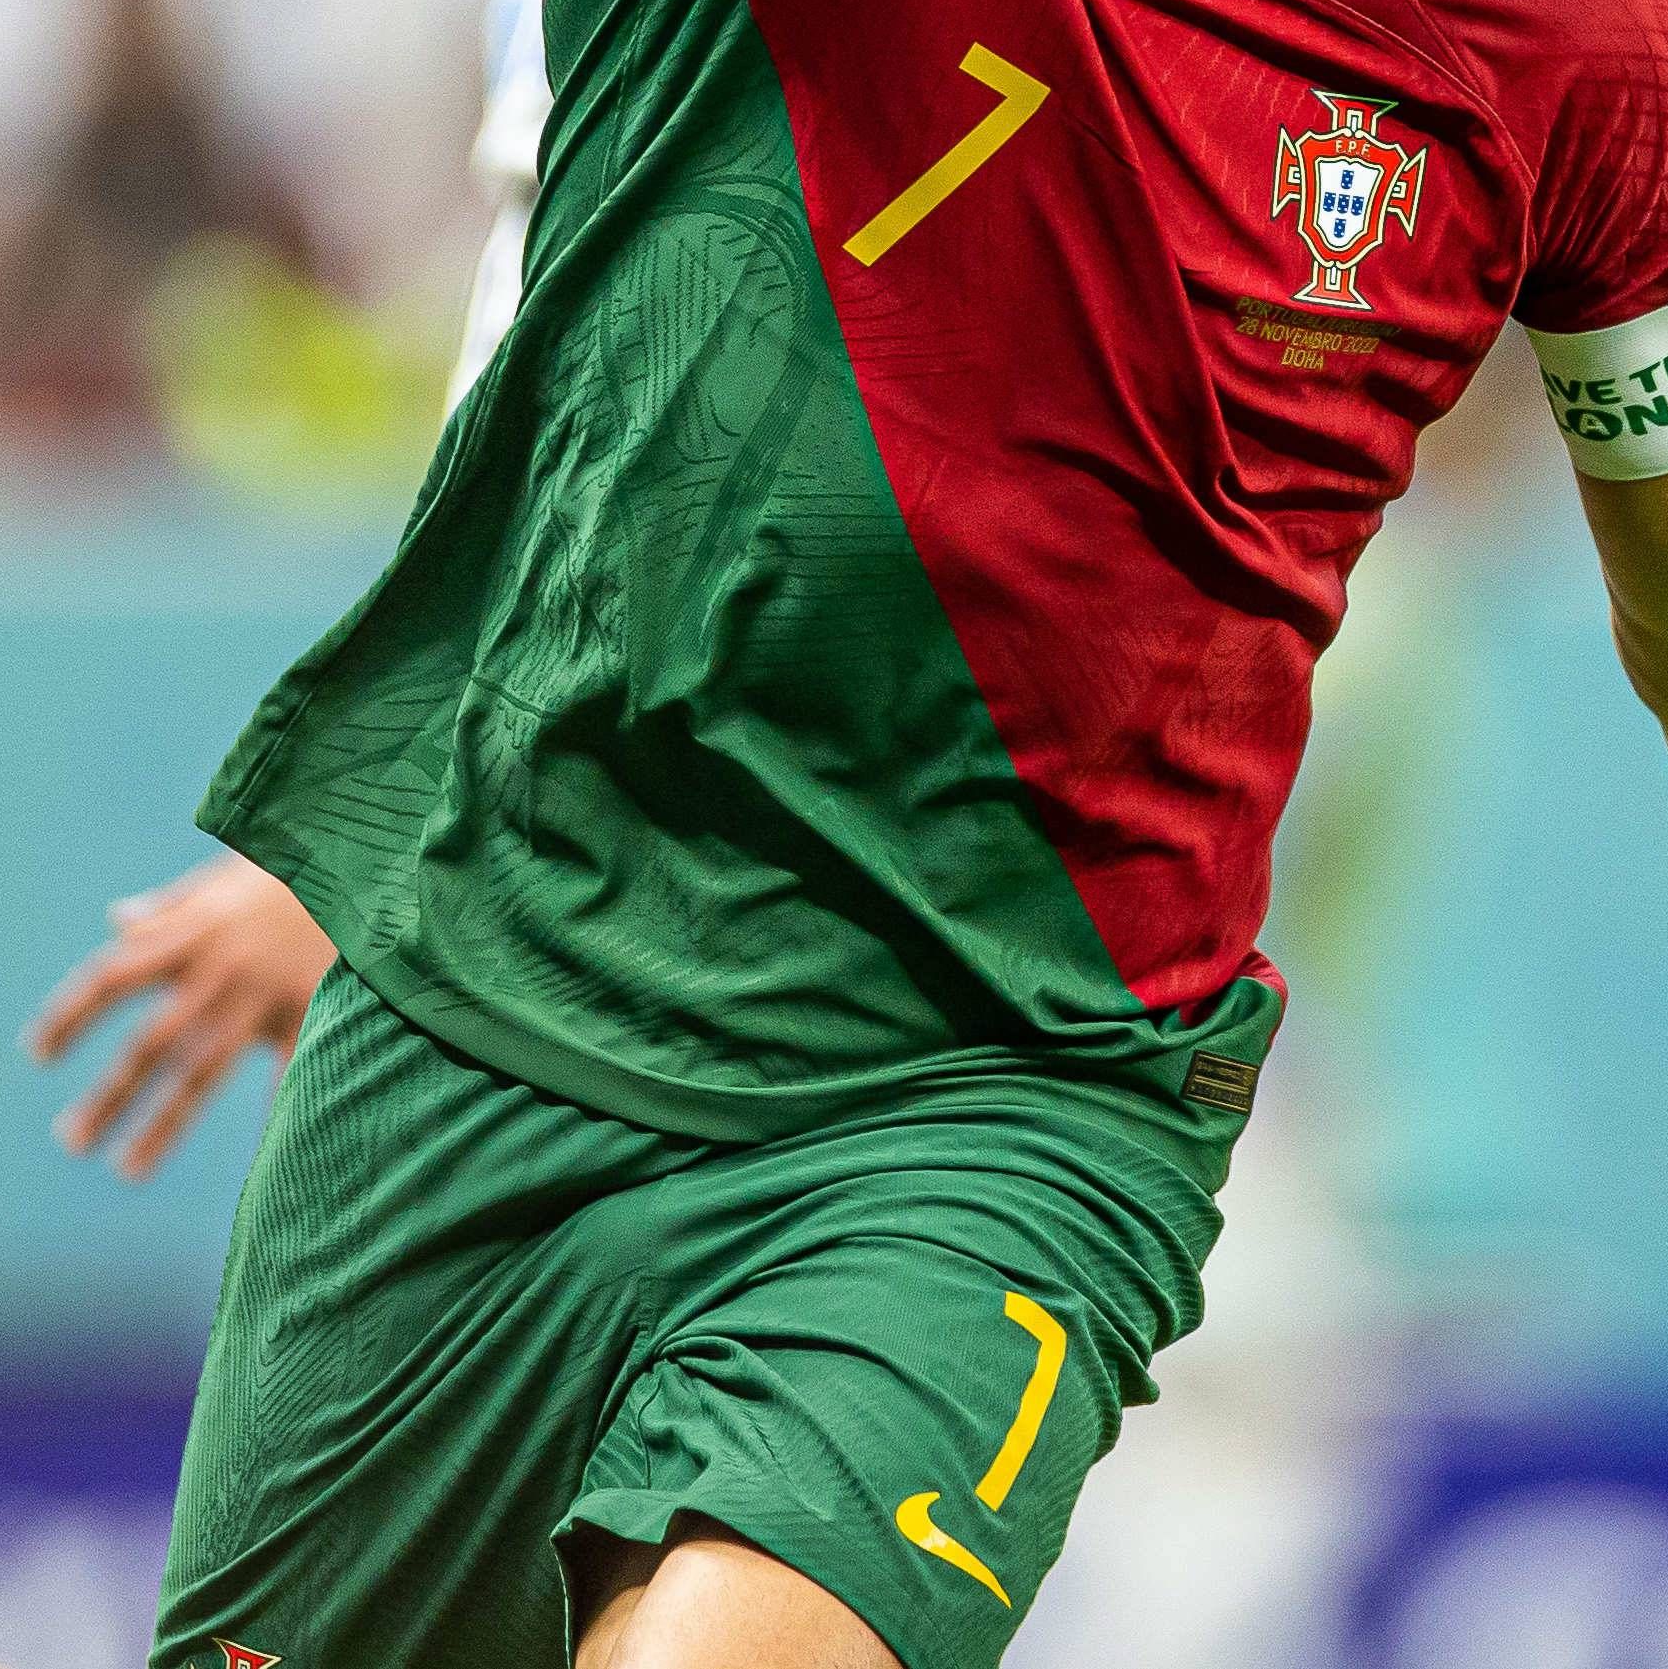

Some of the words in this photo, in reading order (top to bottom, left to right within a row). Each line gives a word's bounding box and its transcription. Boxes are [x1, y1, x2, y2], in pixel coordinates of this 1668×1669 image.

[843, 42, 1051, 266] 7
[1281, 346, 1324, 371] DOHA
[974, 1290, 1067, 1512] 7
